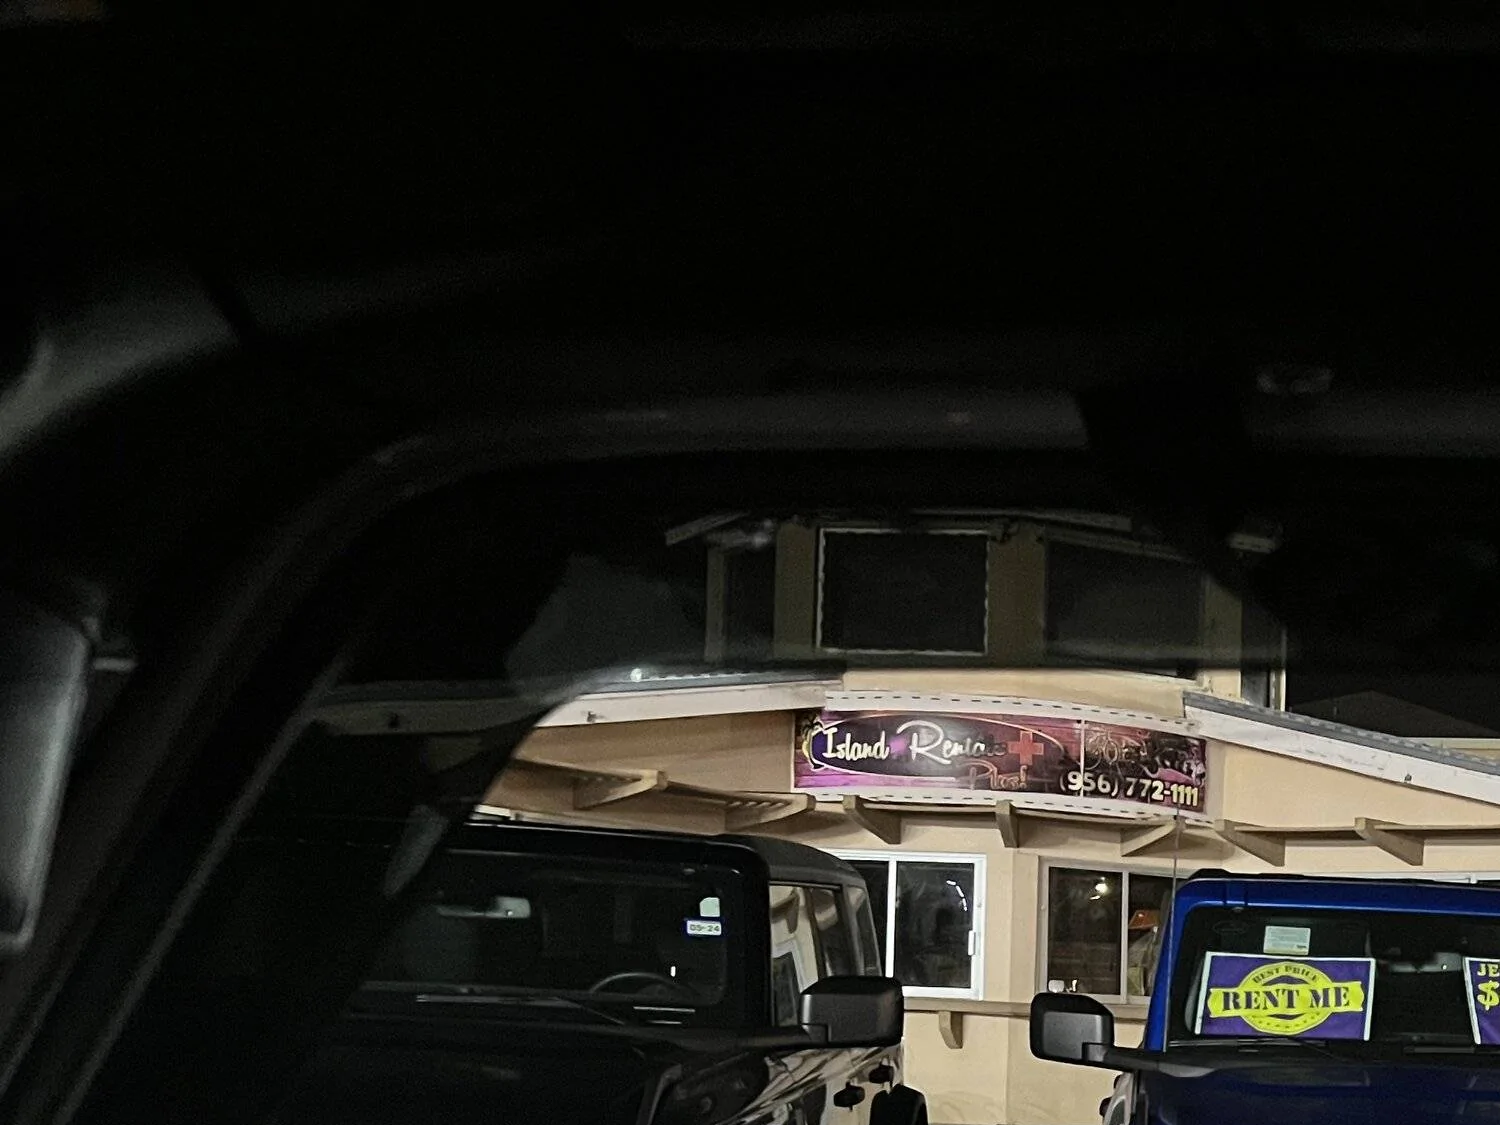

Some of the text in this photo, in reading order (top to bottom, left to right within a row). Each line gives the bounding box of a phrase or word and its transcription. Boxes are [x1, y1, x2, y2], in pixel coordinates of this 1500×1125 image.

[822, 727, 889, 761] Island
[1060, 770, 1199, 808] (956) 772-1111
[1222, 986, 1350, 1012] RENT ME
